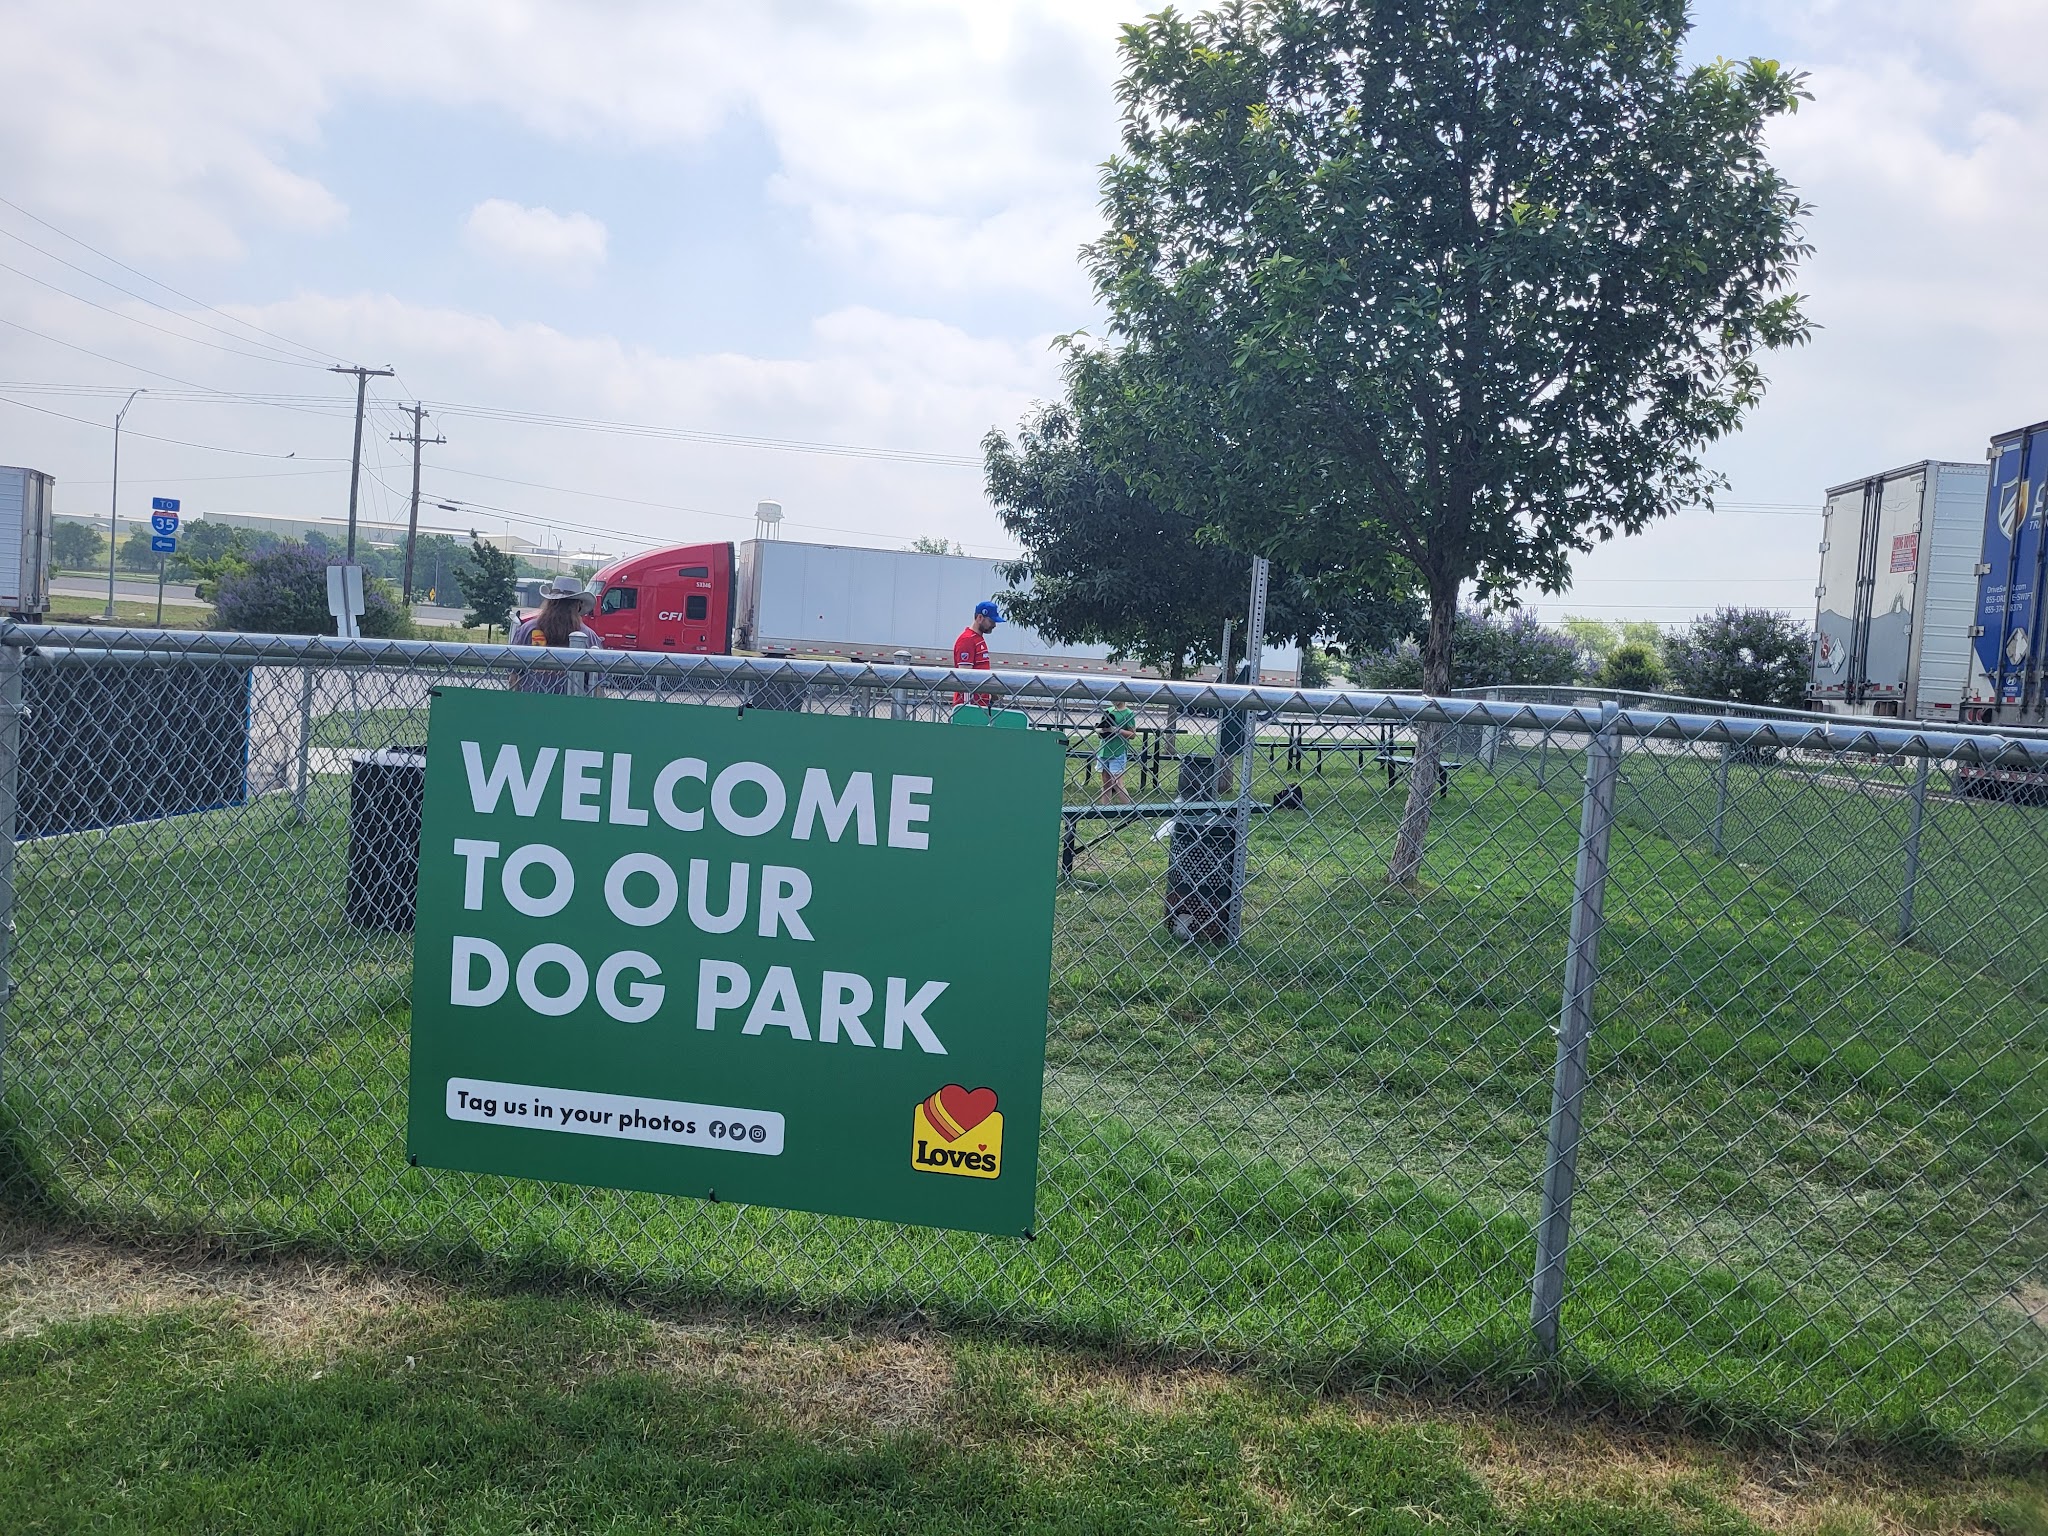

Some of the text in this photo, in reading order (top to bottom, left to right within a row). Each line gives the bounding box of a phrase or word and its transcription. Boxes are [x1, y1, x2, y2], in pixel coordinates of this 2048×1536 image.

[160, 500, 173, 509] TO
[155, 518, 175, 531] 35
[1985, 591, 2034, 604] 855-DRIE-SWIFT
[1984, 603, 2023, 614] 855-3748379
[658, 611, 683, 621] CFI
[461, 741, 933, 850] WELCOME
[453, 838, 815, 941] TO OUR
[450, 935, 950, 1055] DOG PARK
[457, 1090, 696, 1134] Tag us in your photos
